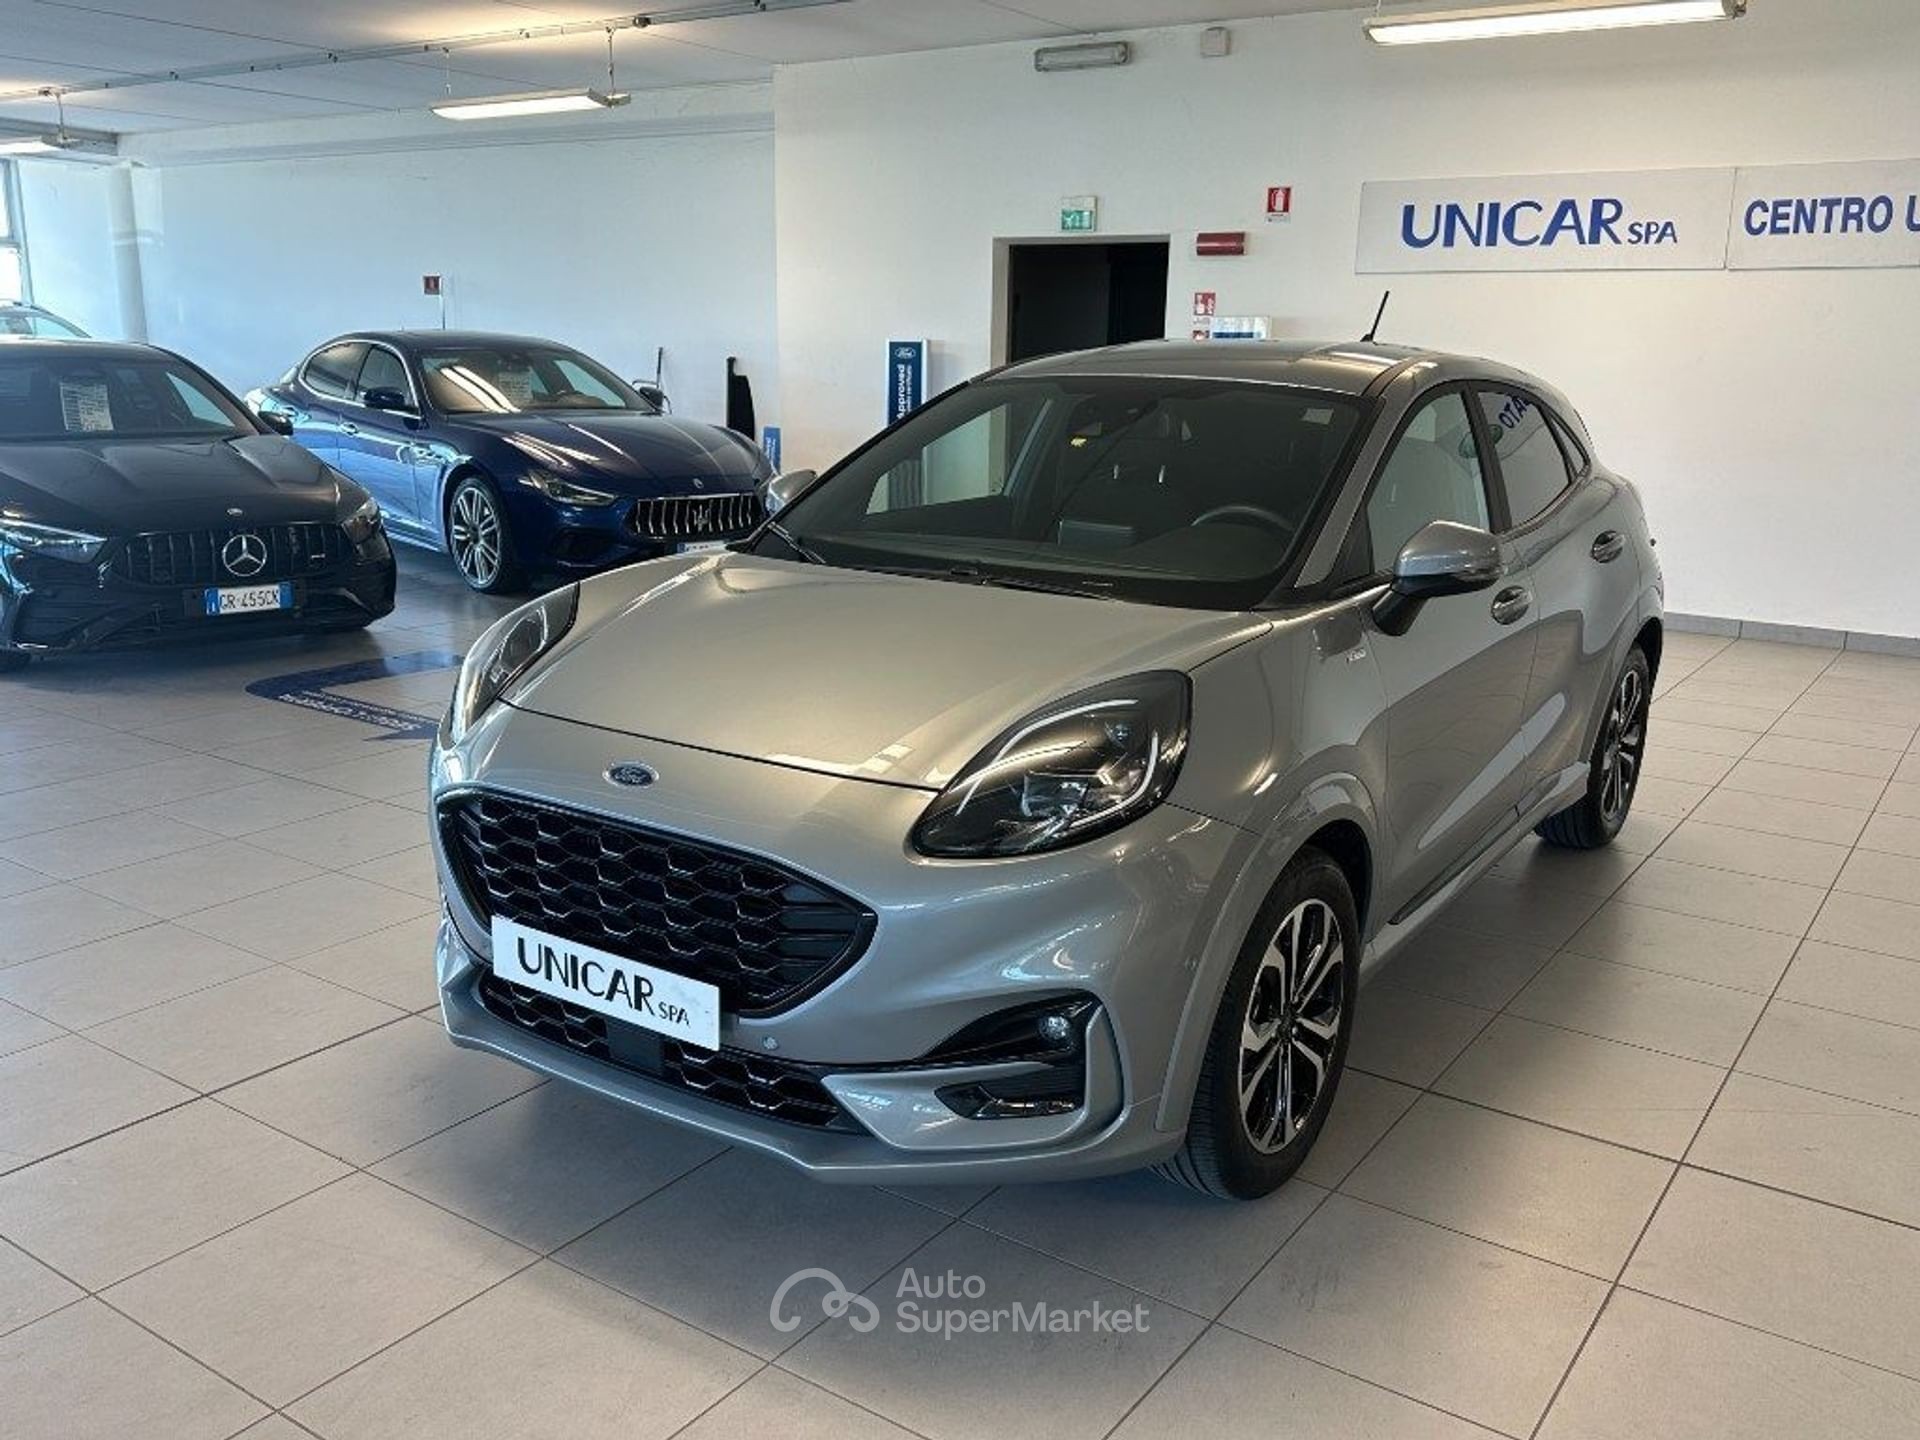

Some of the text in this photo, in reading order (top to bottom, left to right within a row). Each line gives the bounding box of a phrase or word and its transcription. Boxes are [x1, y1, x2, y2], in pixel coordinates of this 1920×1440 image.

[1401, 198, 1679, 248] UNICAR SPA
[1744, 195, 1894, 236] CENTRO
[517, 936, 692, 1028] UNICAR SPA
